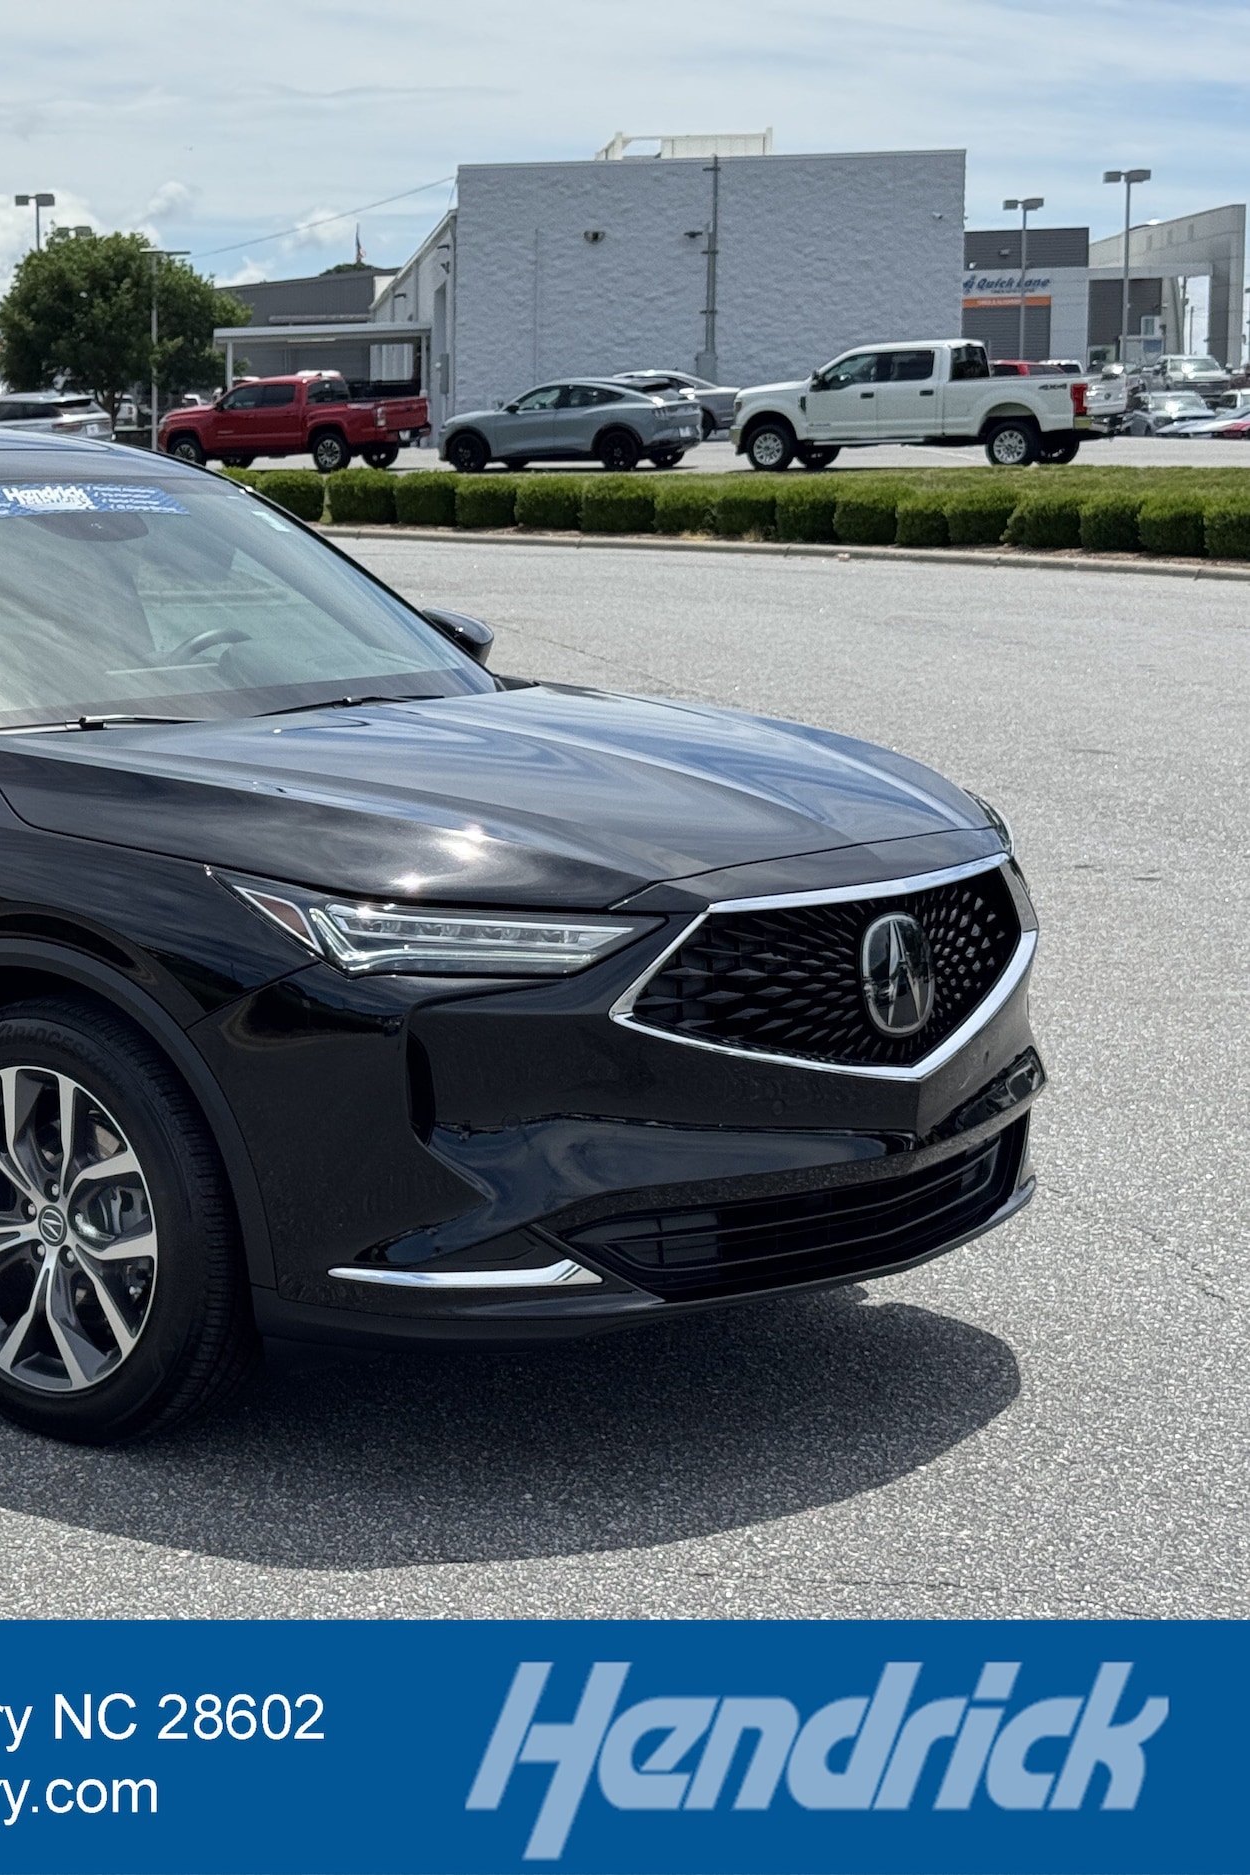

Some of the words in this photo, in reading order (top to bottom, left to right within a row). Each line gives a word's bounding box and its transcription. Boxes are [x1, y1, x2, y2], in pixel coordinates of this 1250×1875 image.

[977, 277, 1015, 290] Quick
[1016, 277, 1050, 288] Lane
[2, 485, 93, 508] Hendrick
